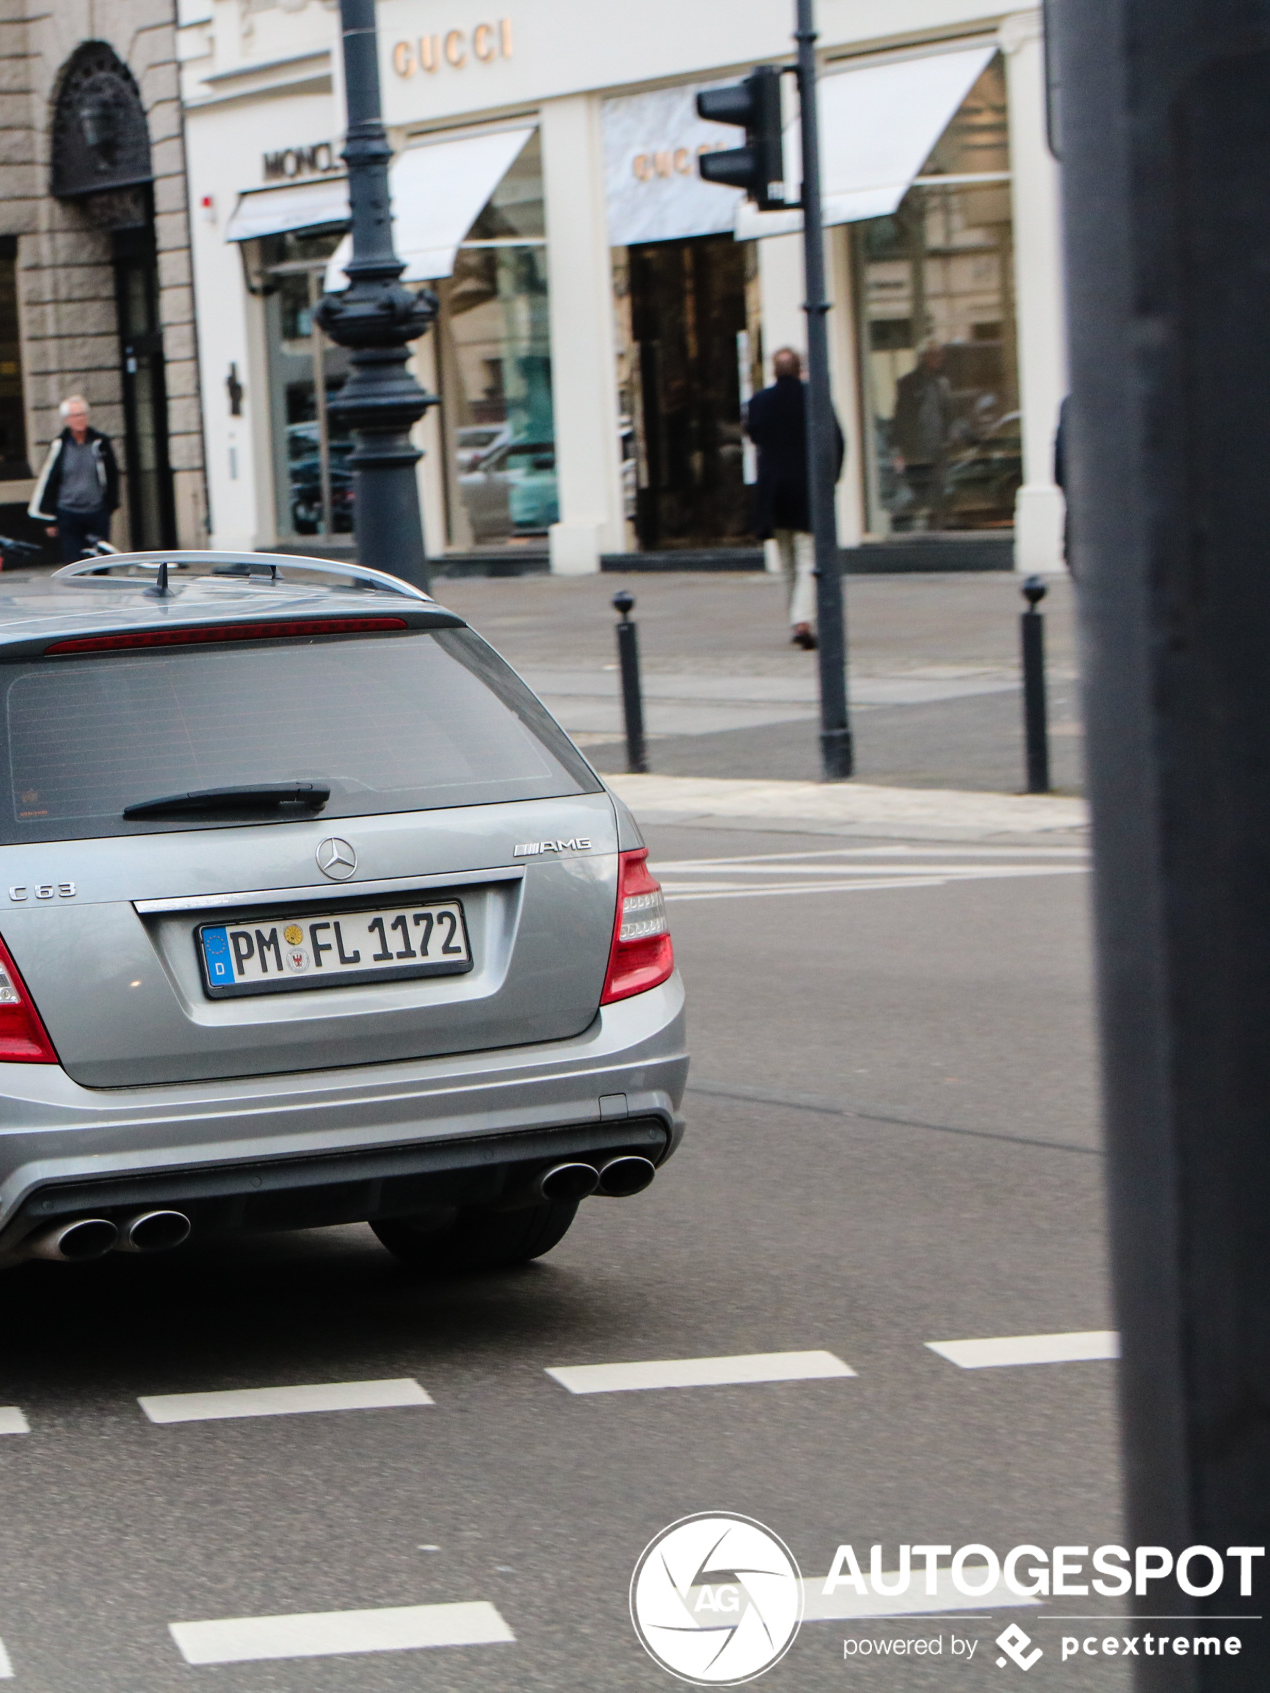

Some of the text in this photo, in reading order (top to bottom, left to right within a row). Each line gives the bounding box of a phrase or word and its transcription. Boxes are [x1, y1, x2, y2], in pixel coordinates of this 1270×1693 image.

[392, 18, 513, 79] GUCCI
[263, 142, 345, 180] MONCL
[634, 142, 727, 181] GUC
[539, 837, 592, 855] AMG
[9, 881, 77, 902] C 63
[229, 910, 462, 976] PM FL 1172
[214, 962, 226, 976] D
